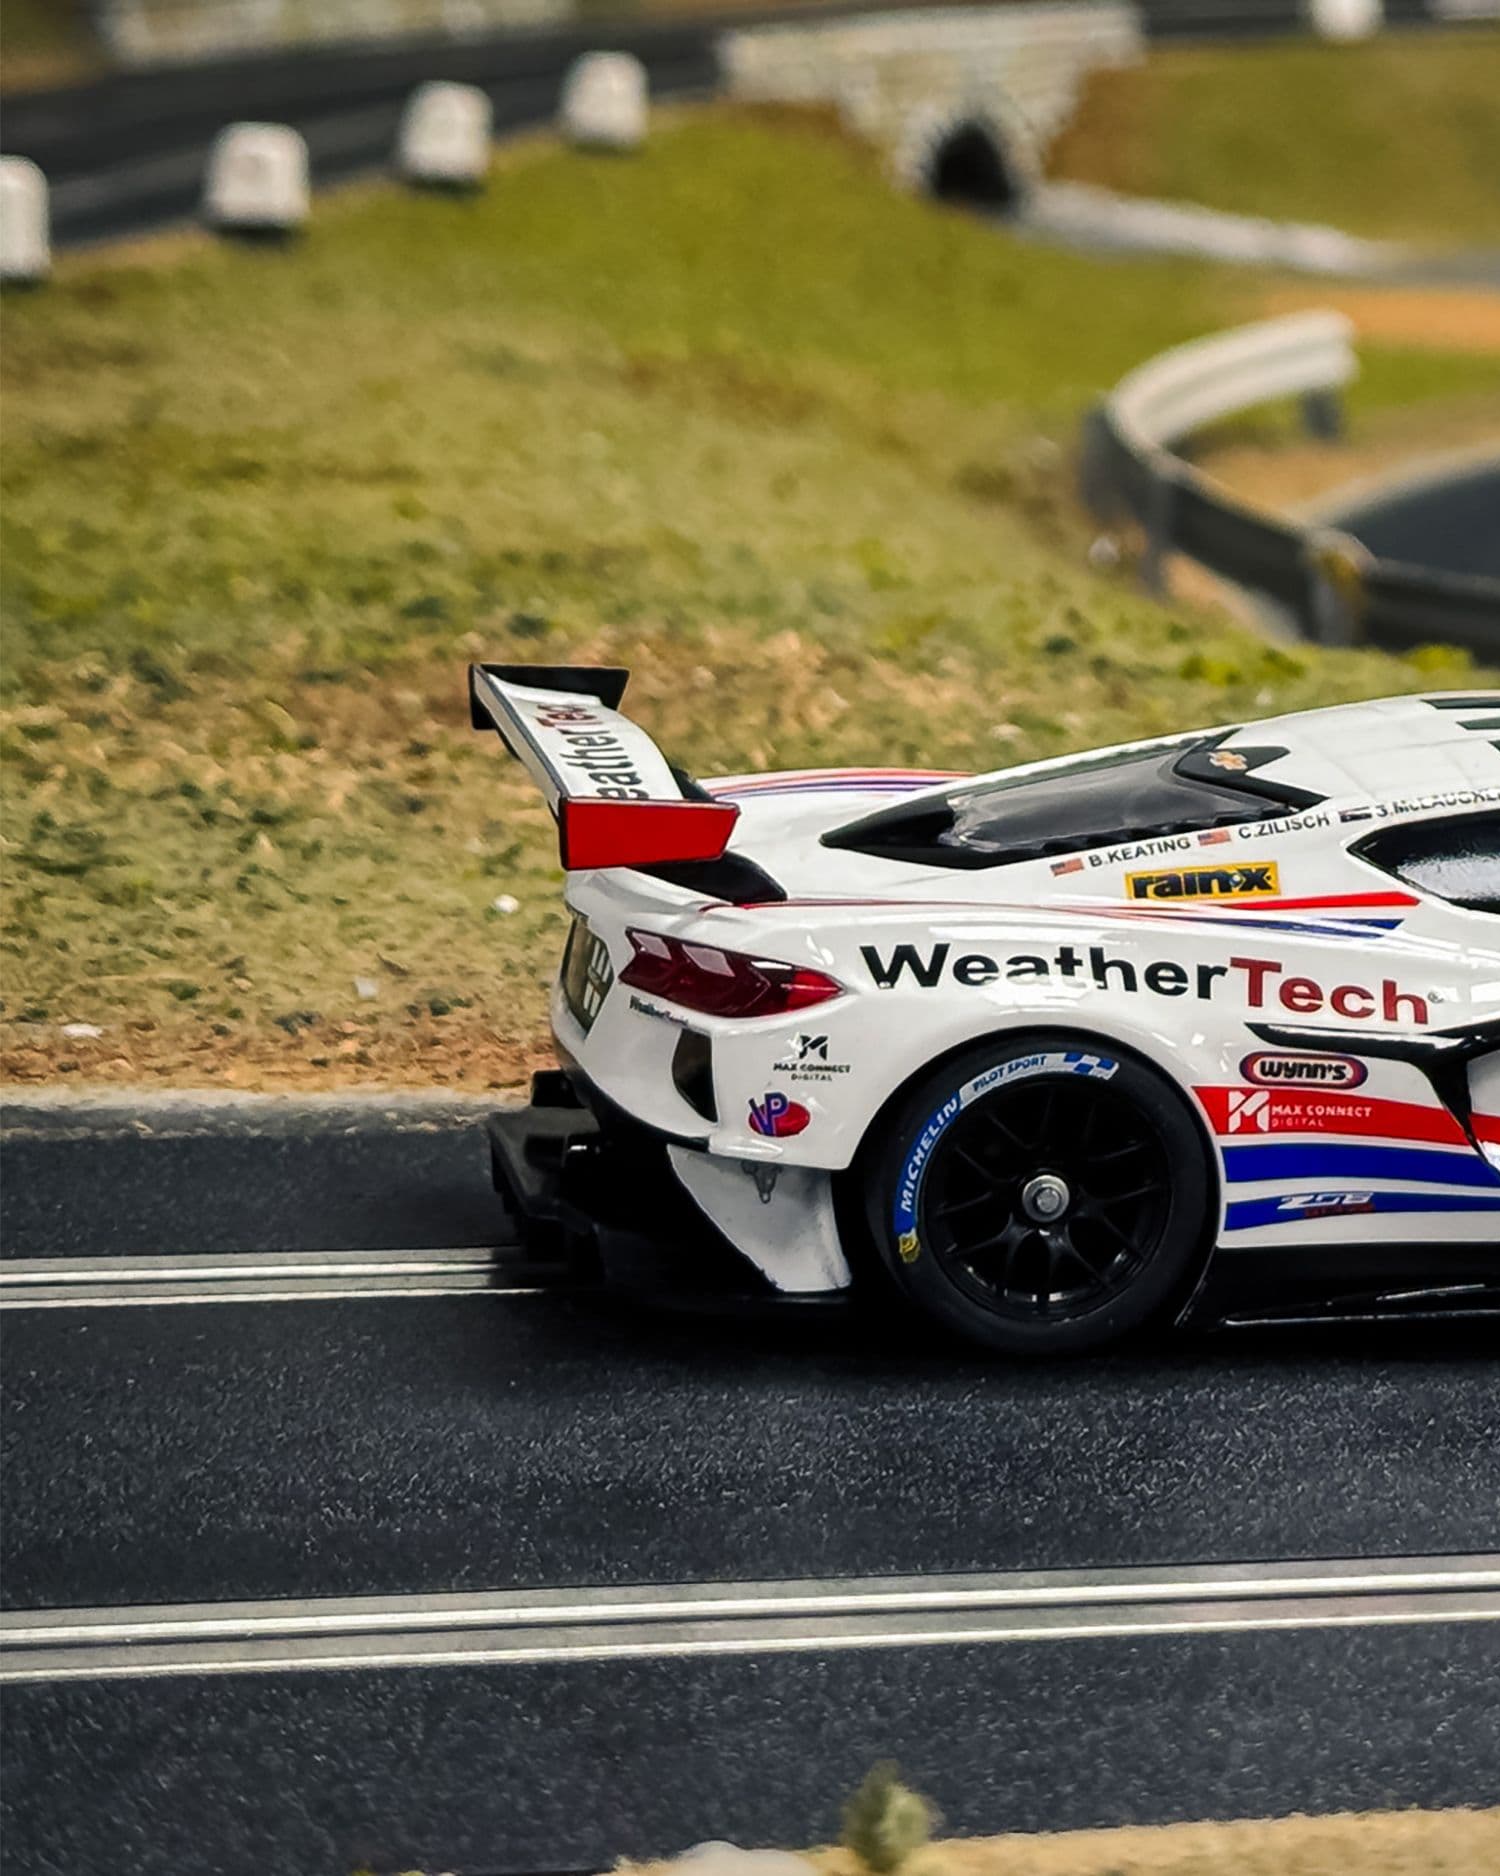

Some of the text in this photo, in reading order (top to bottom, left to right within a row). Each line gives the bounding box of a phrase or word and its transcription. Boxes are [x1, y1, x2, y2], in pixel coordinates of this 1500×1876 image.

[1238, 813, 1330, 840] C.ZILISCH
[1088, 837, 1192, 868] B.KEATING
[859, 942, 1430, 1026] WeatherTech
[773, 1062, 851, 1074] MAX CONNECT
[972, 1055, 1048, 1092] PILOT SPORT
[1259, 1060, 1347, 1081] wynn's
[748, 1091, 789, 1137] VP
[1271, 1104, 1373, 1118] MAX CONNECT
[1271, 1117, 1325, 1128] DIGITAL
[901, 1097, 959, 1213] MICHELIN
